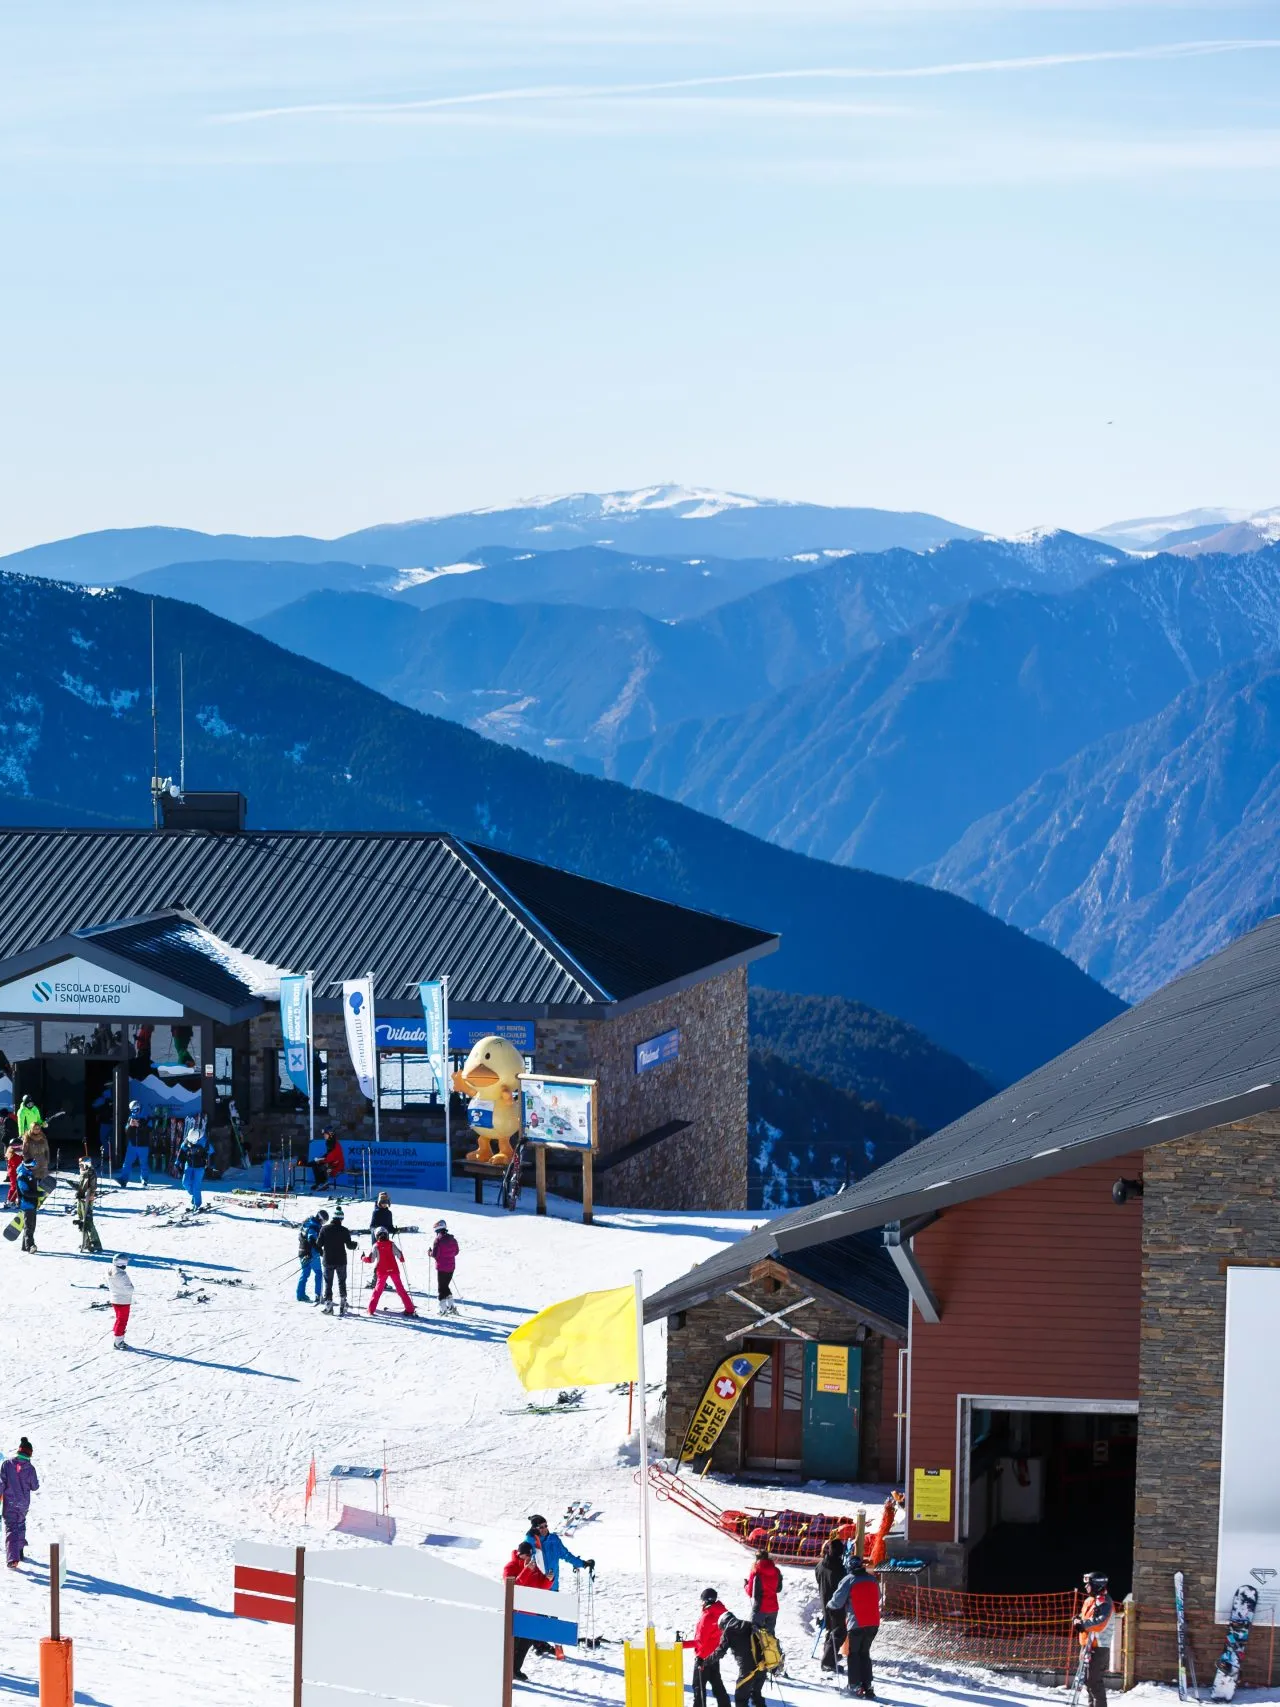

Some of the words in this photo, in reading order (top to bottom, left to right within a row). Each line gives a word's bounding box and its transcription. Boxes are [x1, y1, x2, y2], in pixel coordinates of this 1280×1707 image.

[55, 983, 91, 993] ESCOLA
[93, 982, 131, 993] D'ESQUÍ
[60, 994, 121, 1004] SNOWBOARD
[683, 1400, 717, 1454] SERVEI
[703, 1406, 727, 1446] PISTES
